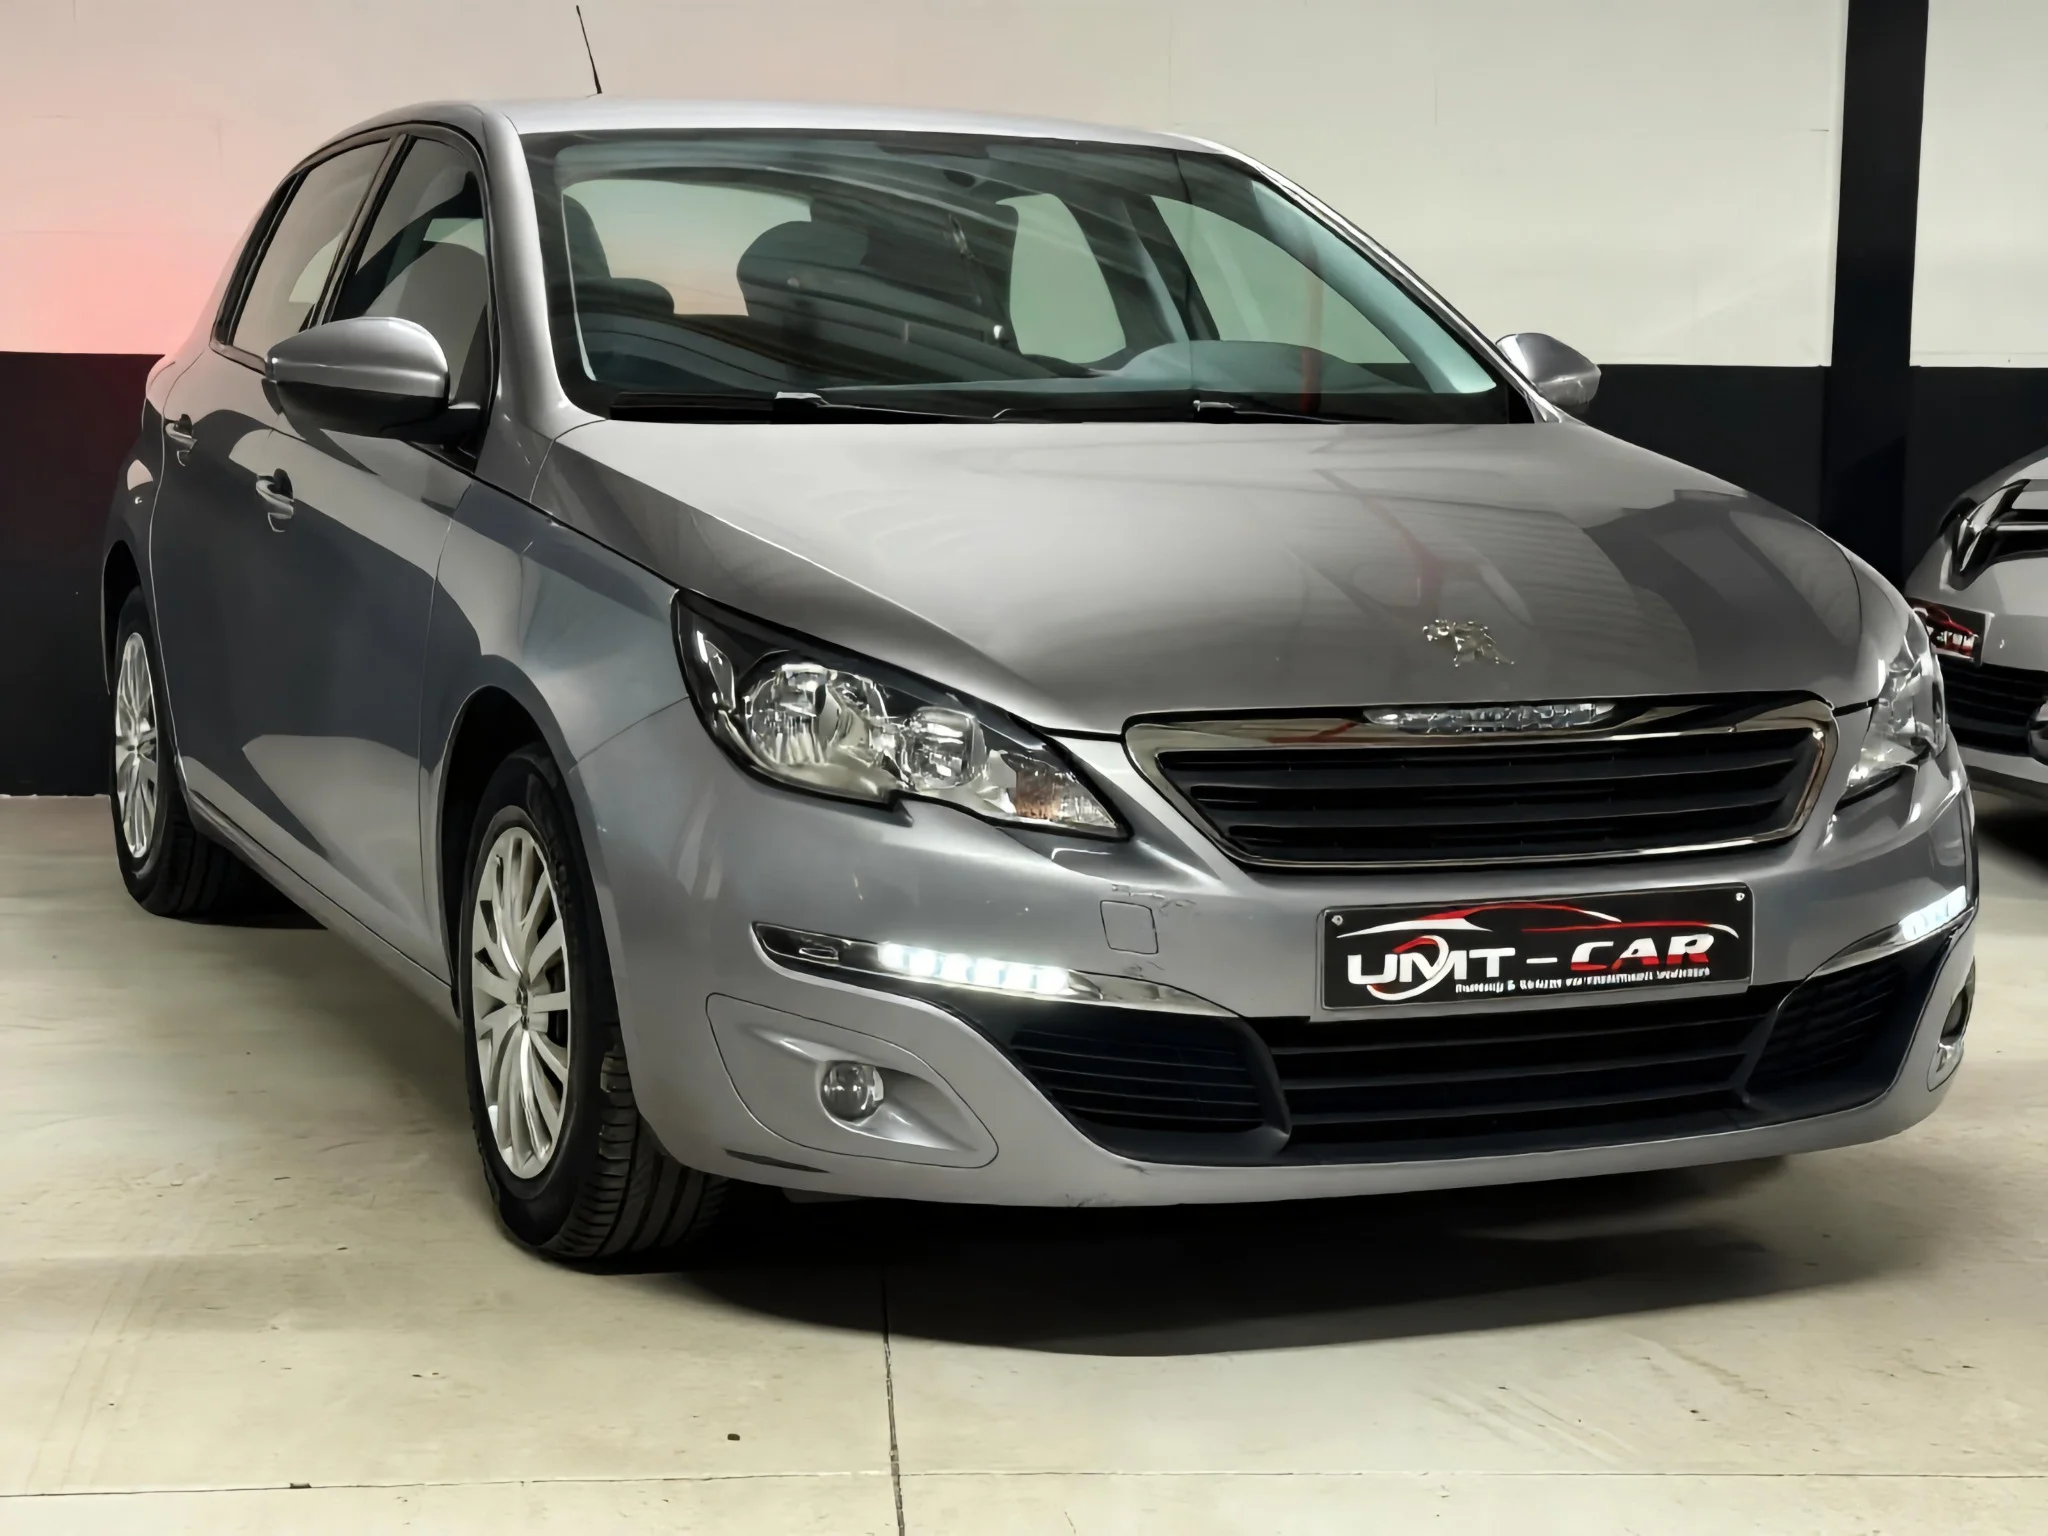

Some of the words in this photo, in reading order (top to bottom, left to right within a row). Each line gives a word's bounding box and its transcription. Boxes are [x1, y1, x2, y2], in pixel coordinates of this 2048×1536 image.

[1347, 938, 1516, 992] UMT
[1526, 956, 1558, 965] -
[1570, 933, 1715, 971] CAR
